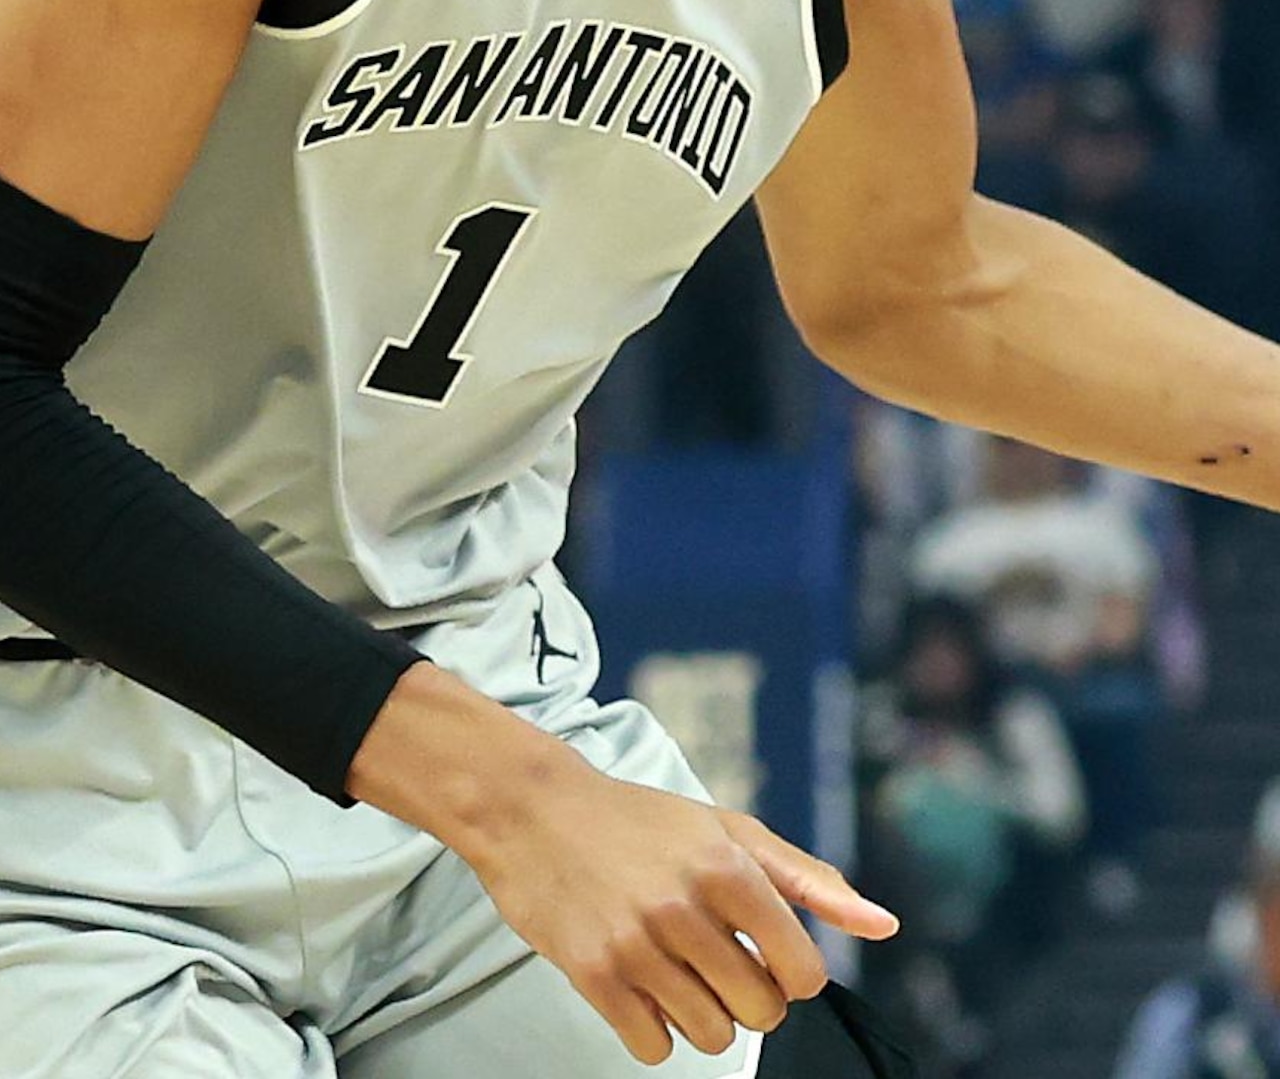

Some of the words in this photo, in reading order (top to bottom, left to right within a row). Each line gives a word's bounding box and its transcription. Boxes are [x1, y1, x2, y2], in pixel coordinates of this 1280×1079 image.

[299, 32, 526, 151] SAN
[488, 20, 755, 200] ANTONIO
[358, 202, 538, 408] 1
